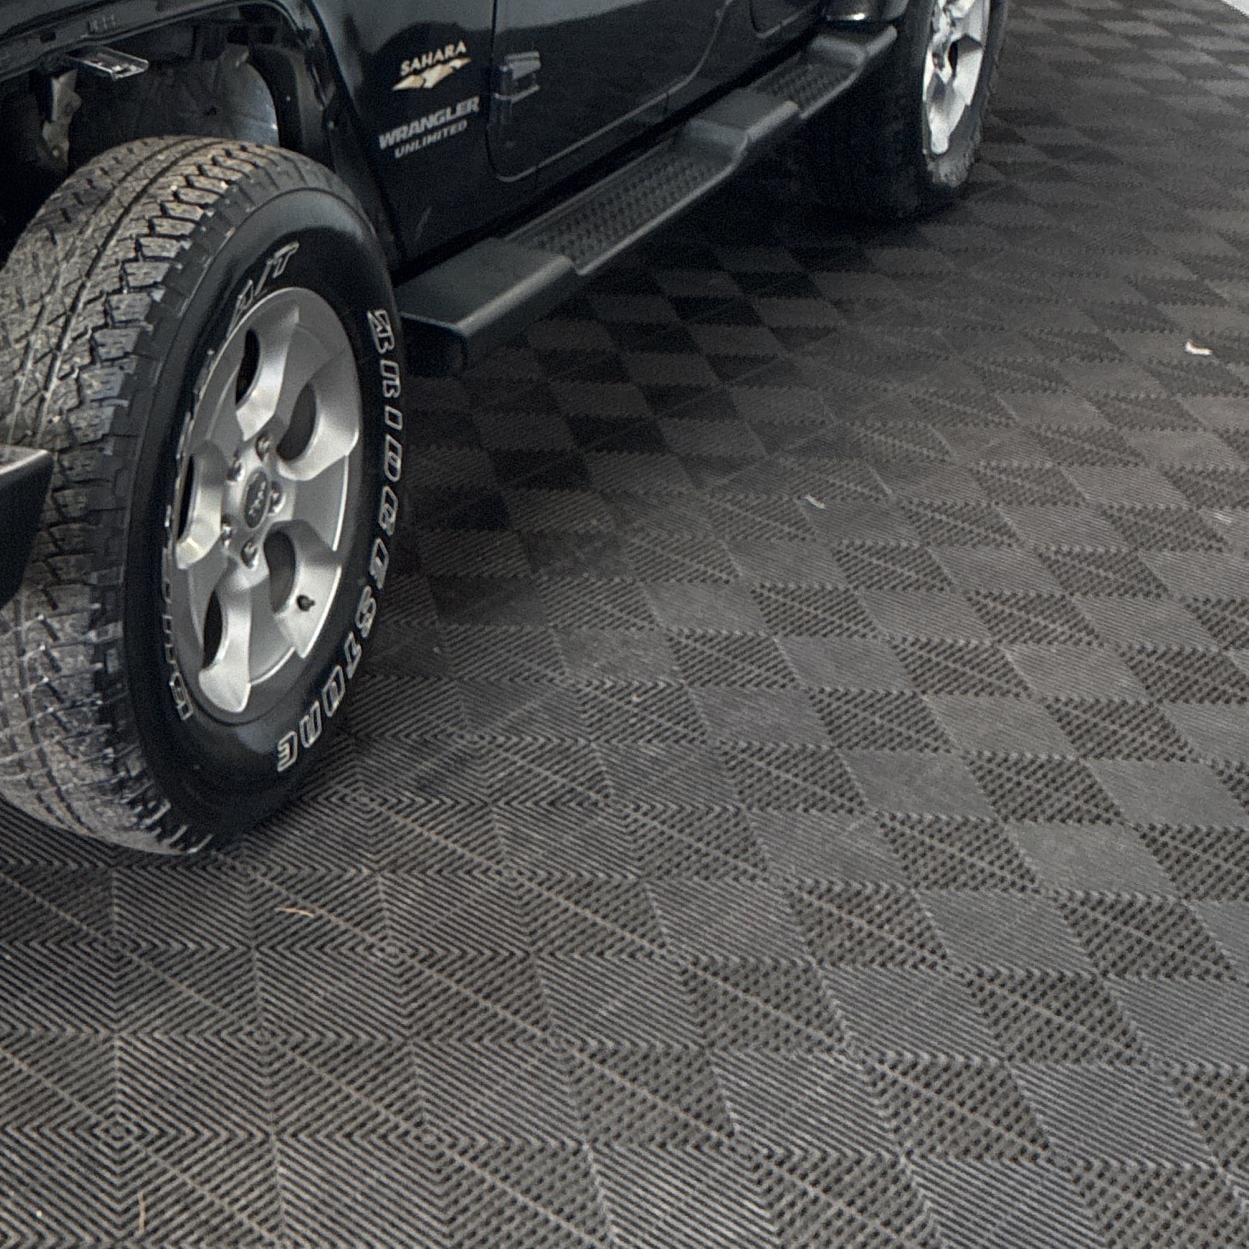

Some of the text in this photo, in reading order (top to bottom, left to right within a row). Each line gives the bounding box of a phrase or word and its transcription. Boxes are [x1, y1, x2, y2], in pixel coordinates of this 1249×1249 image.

[400, 40, 467, 77] SAHARA
[378, 95, 481, 151] WRANGLER
[394, 119, 468, 159] UNLIMITED
[276, 308, 404, 772] BRIDGESTONE
